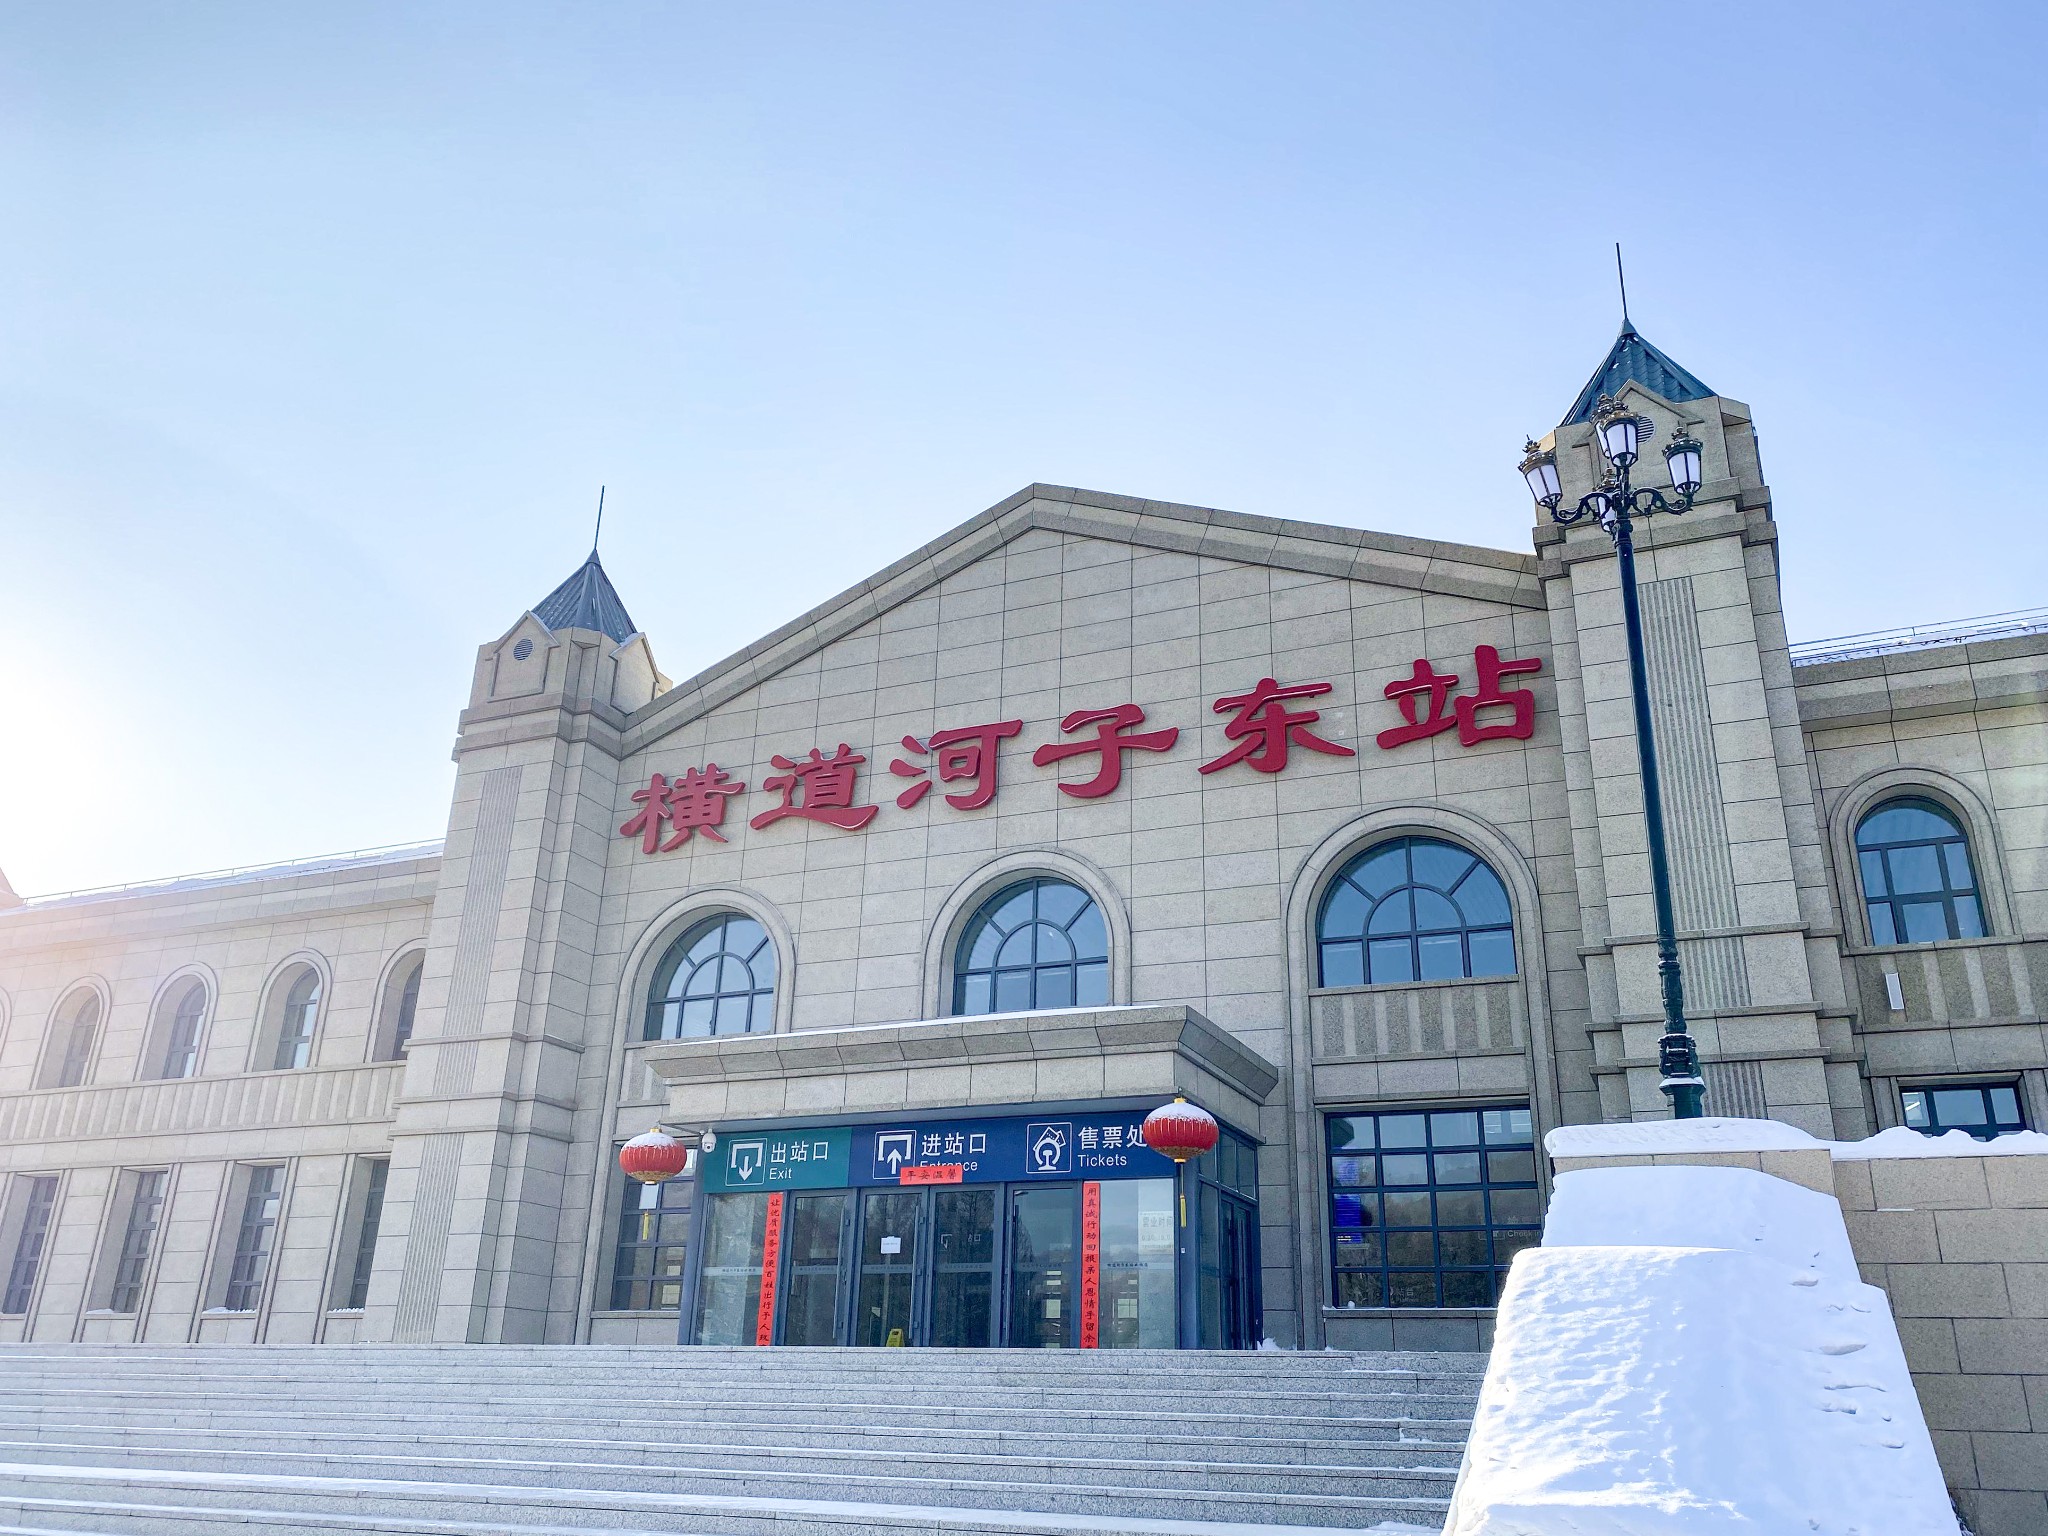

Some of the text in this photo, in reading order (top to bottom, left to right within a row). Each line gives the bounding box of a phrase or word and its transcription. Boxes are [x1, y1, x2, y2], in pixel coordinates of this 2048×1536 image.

[620, 644, 1542, 855] 横道河子东站
[921, 1132, 987, 1156] 进站口
[1077, 1124, 1147, 1150] 售票处
[770, 1141, 829, 1164] 出站口
[1077, 1154, 1128, 1168] Tickets
[769, 1167, 793, 1180] Exit
[905, 1168, 957, 1182] 平安温馨
[758, 1198, 781, 1346] 让优质服务方便百姓出行予人玫
[1083, 1187, 1098, 1348] 用真诚行动回报亲人恩情手留余
